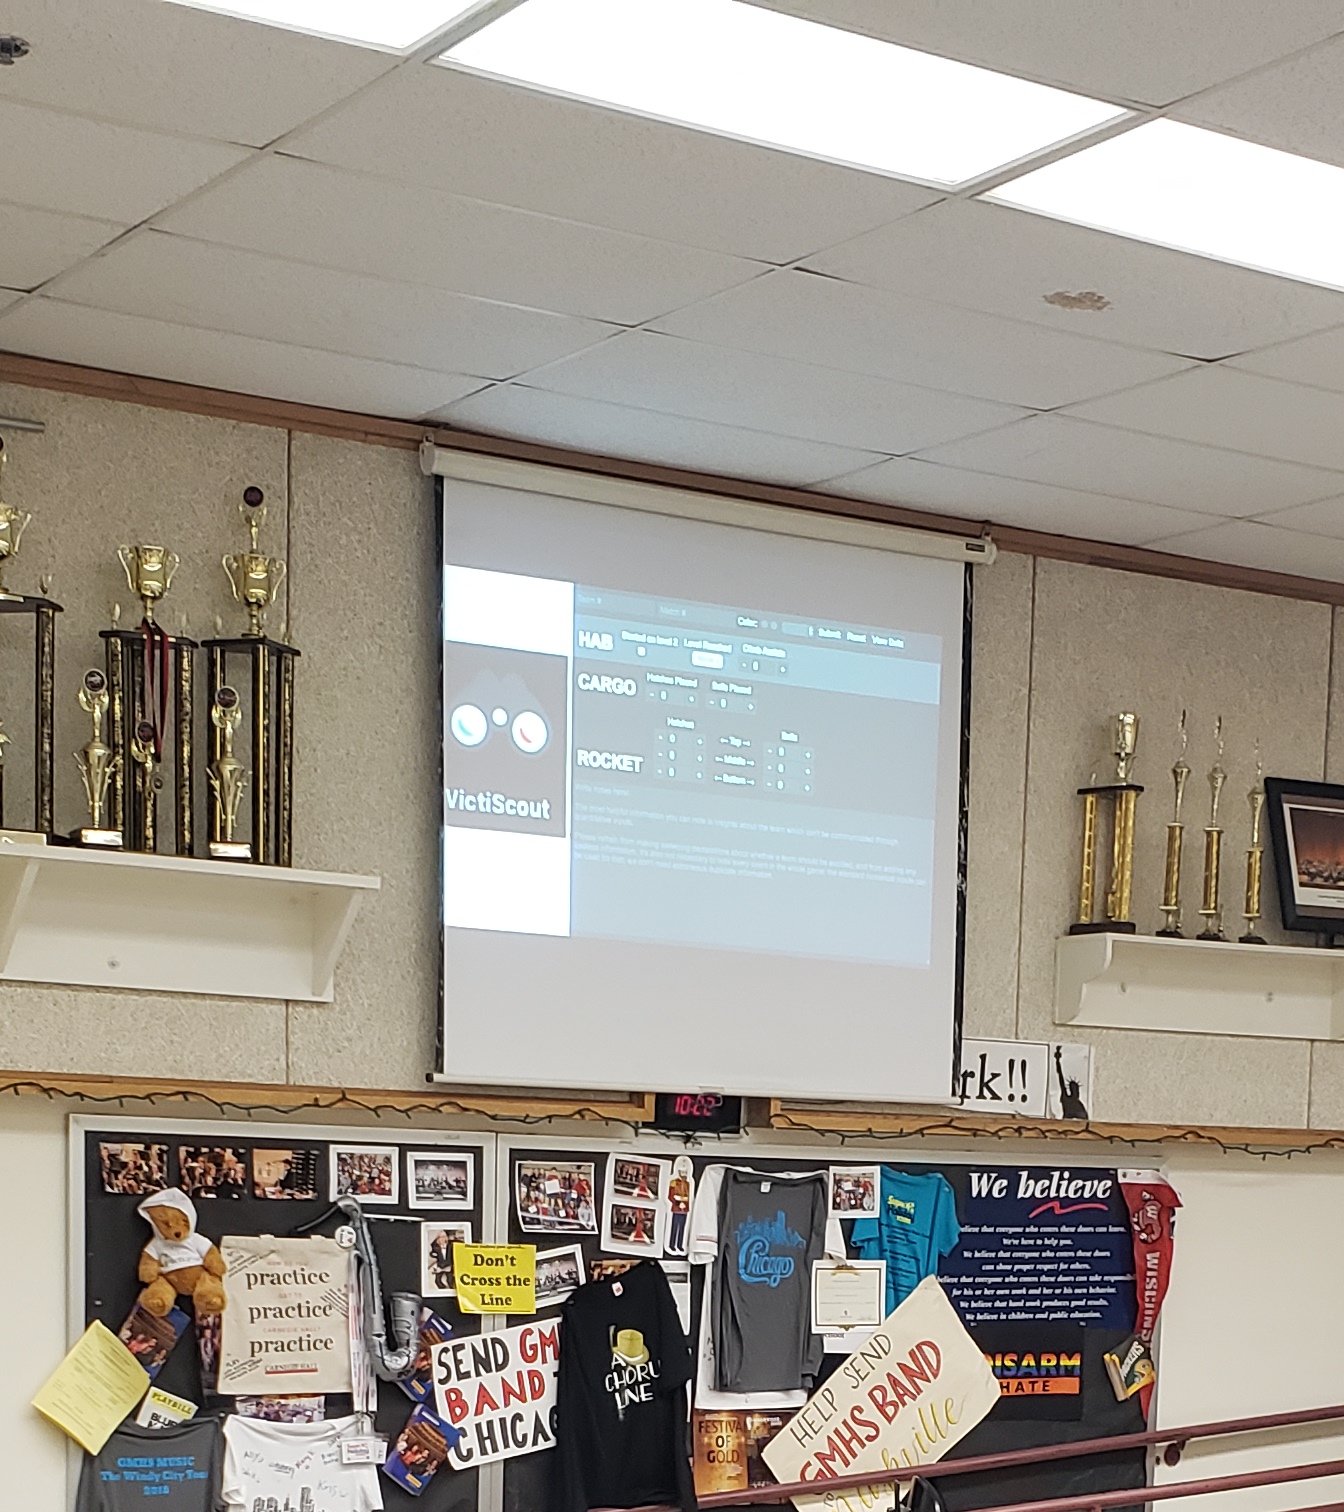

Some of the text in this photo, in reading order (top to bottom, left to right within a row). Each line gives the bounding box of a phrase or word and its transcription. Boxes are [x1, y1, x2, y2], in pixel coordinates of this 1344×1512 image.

[578, 630, 614, 650] HAB
[577, 673, 637, 696] CARGO
[576, 749, 644, 773] ROCKET
[445, 788, 550, 820] VictiScout
[969, 1170, 1113, 1199] We believe
[472, 1253, 517, 1267] Don't
[738, 1235, 795, 1288] Chicago
[245, 1267, 331, 1290] practice
[459, 1273, 531, 1287] Cross the
[479, 1293, 512, 1306] Line
[248, 1300, 333, 1324] practice
[249, 1334, 334, 1357] practice
[437, 1336, 510, 1386] SEND
[611, 1352, 627, 1370] A
[790, 1387, 838, 1448] HELP
[843, 1334, 892, 1390] SEND
[867, 1340, 942, 1425] BAND
[1000, 1379, 1050, 1394] HATE
[151, 1391, 193, 1414] PLAYBILL
[444, 1369, 546, 1425] BAND
[716, 1435, 732, 1448] OF
[156, 1455, 195, 1468] MUSIC
[707, 1449, 740, 1463] GOLD
[99, 1470, 121, 1481] The
[122, 1470, 161, 1483] Windy
[162, 1470, 185, 1482] City
